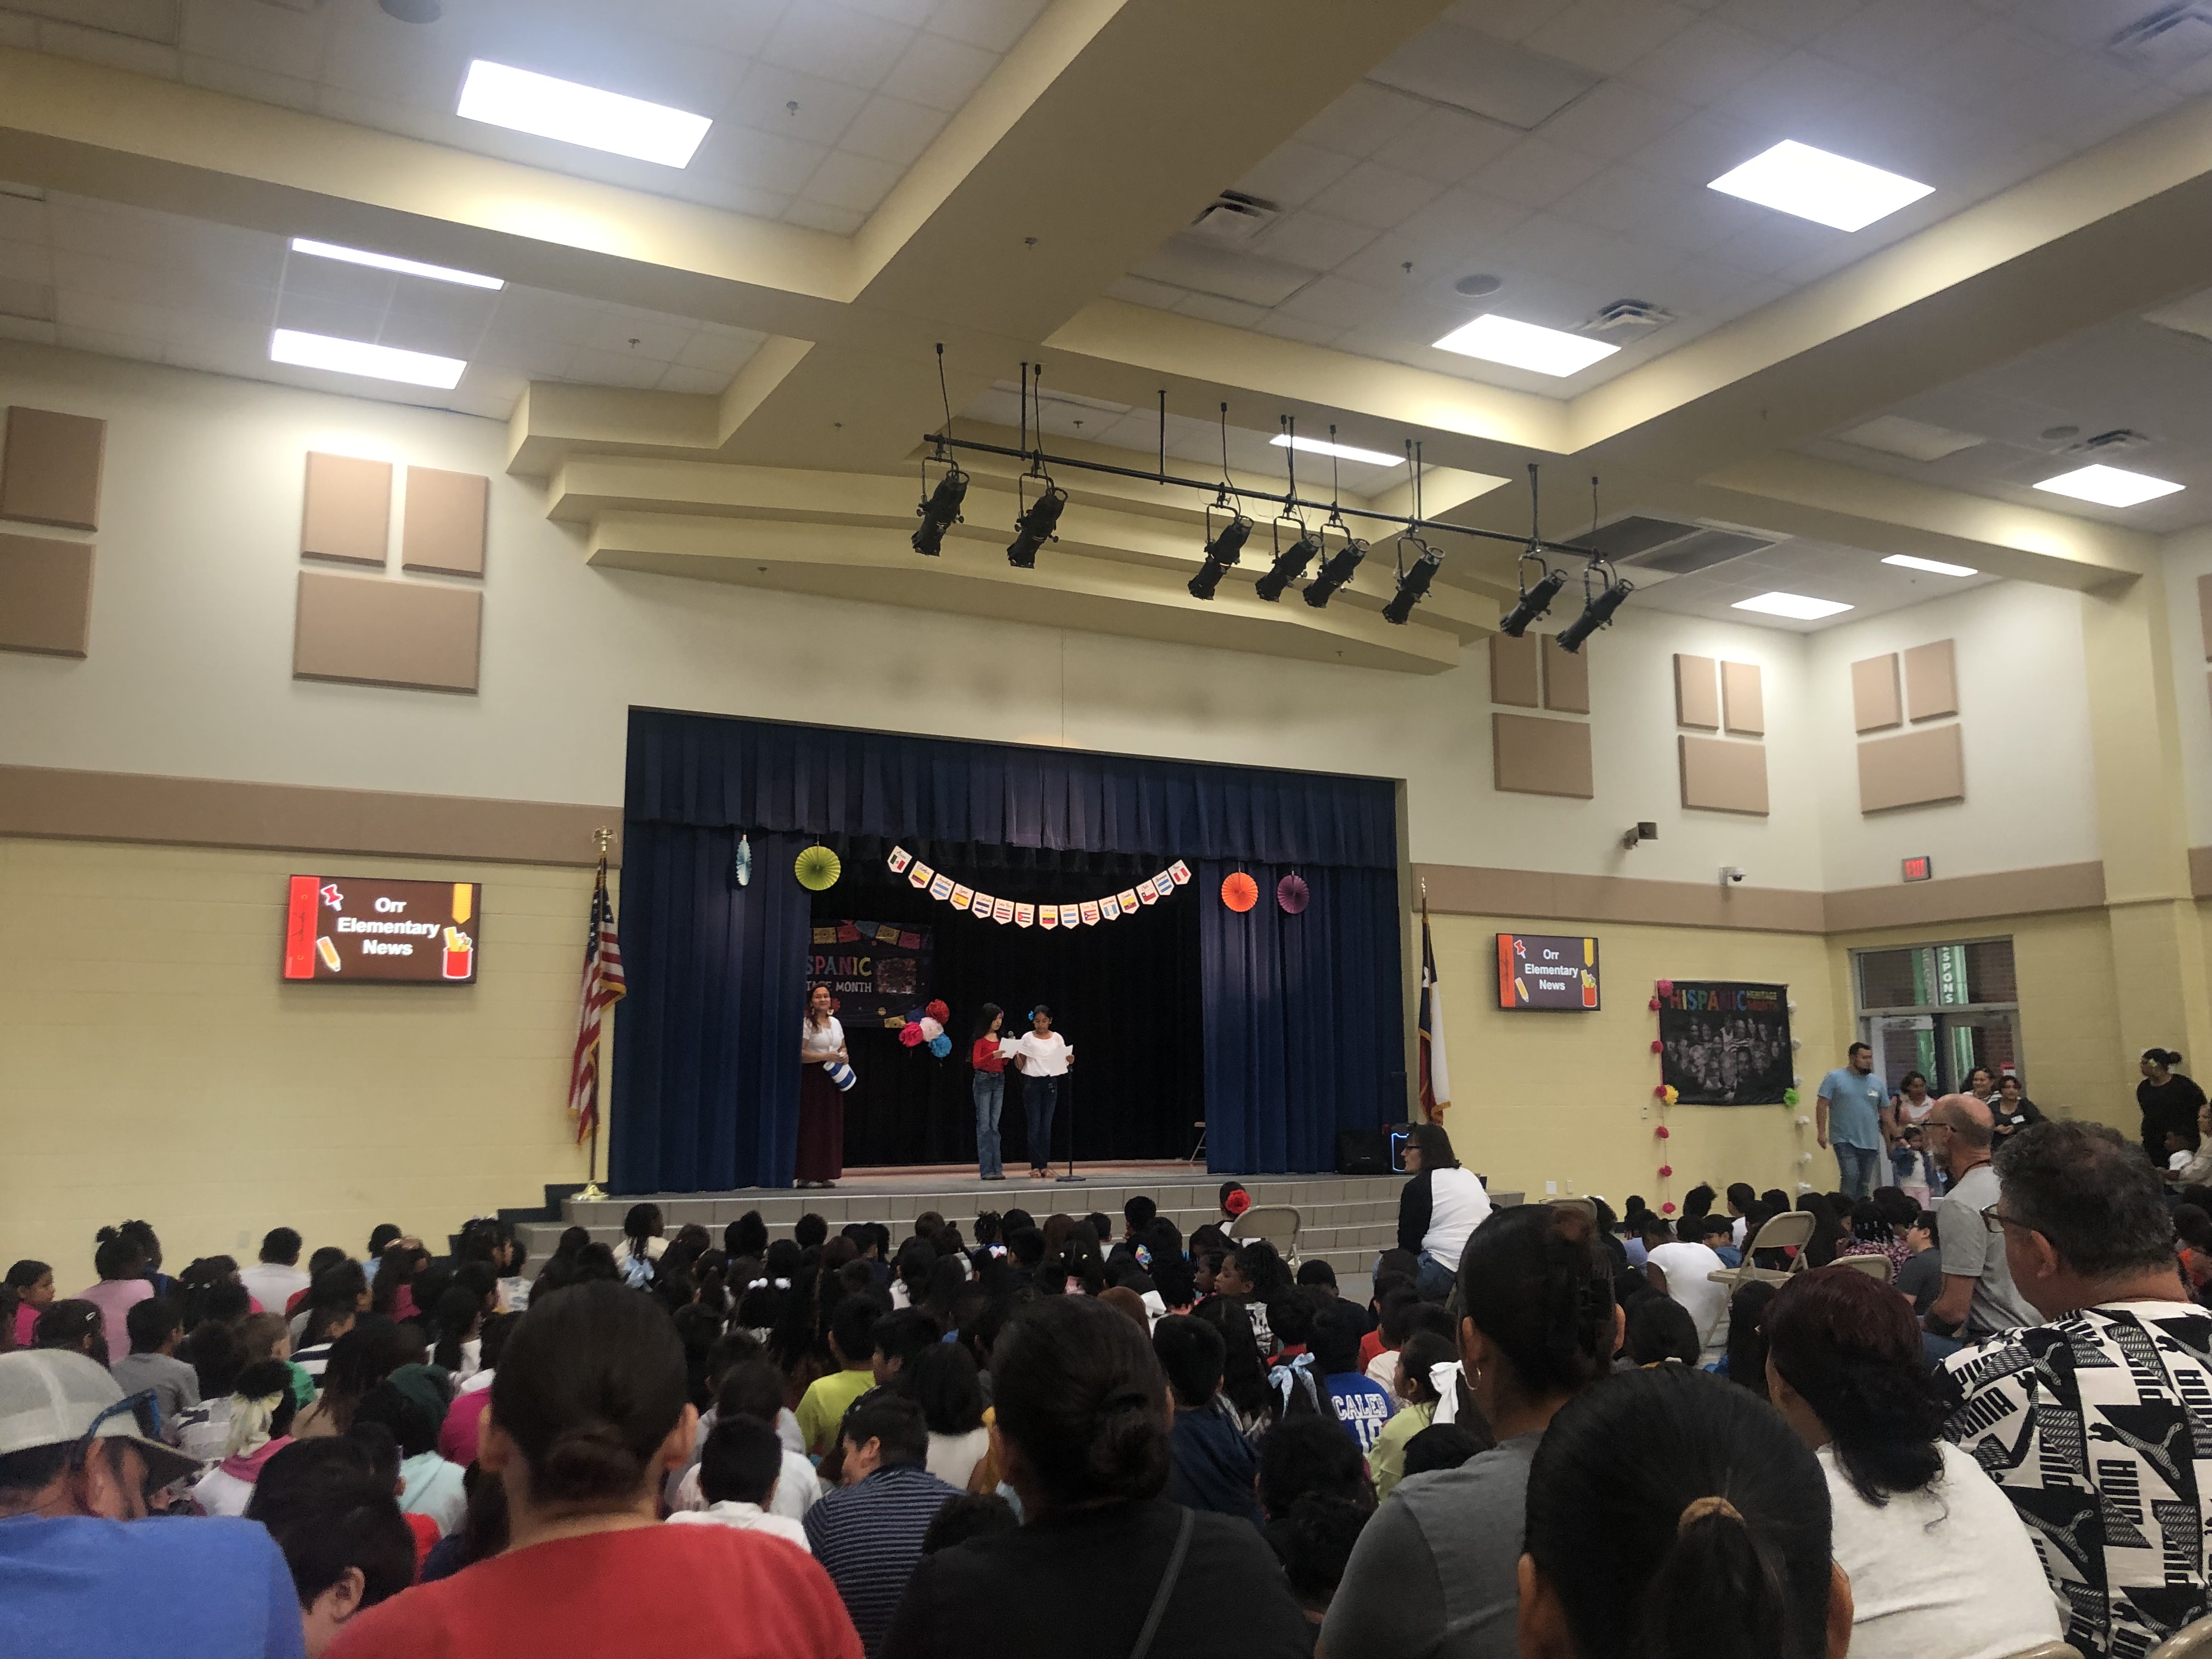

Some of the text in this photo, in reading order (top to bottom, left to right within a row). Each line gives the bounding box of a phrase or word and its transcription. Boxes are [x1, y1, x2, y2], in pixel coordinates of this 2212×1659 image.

[375, 898, 407, 912] Orr
[337, 917, 441, 938] Elementary
[363, 940, 413, 956] News
[1543, 949, 1559, 960] Orr
[1525, 964, 1578, 978] Elementary
[836, 981, 872, 992] MONTH
[1539, 980, 1565, 990] News
[1670, 989, 1747, 1012] HISPANIC
[1331, 1394, 1387, 1420] CALEB
